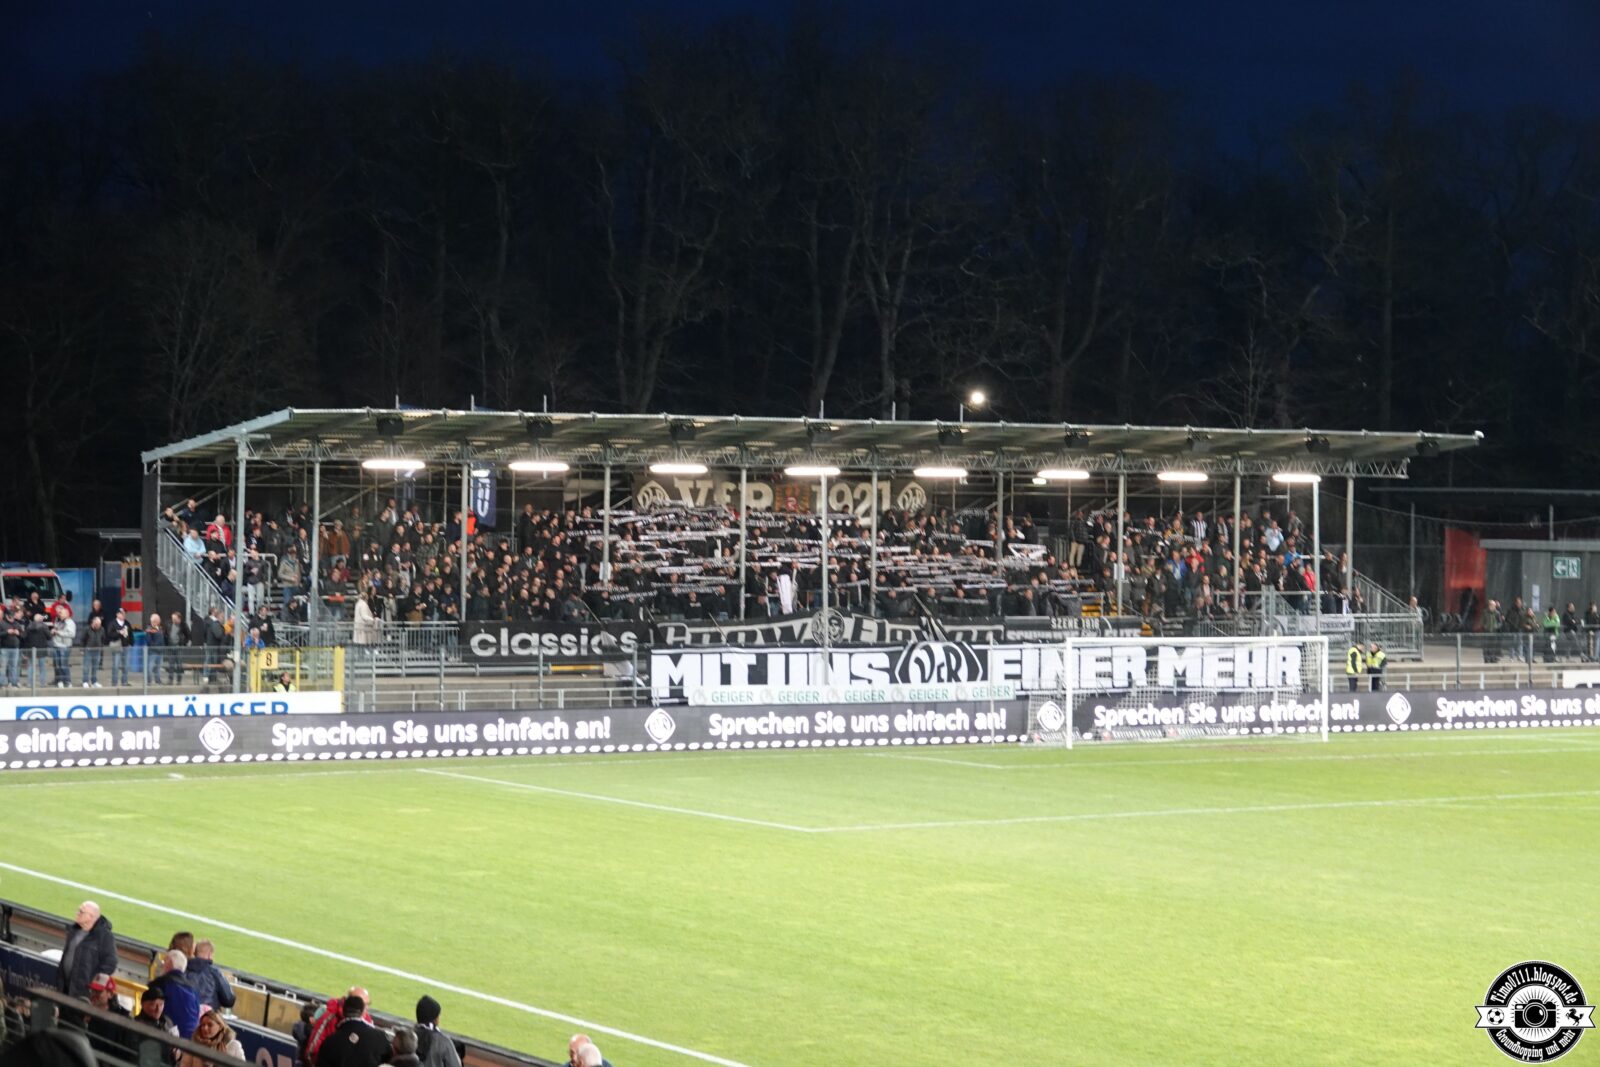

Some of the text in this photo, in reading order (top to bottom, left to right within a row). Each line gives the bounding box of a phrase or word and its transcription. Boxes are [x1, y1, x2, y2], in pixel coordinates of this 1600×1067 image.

[265, 652, 273, 667] 8
[651, 652, 756, 698] MIT
[768, 652, 890, 687] UNS
[992, 647, 1147, 690] EINER
[1158, 646, 1301, 688] MEHR
[711, 690, 754, 703] GEIGER
[778, 690, 820, 702] GEIGER
[844, 689, 887, 702] GEIGER
[908, 687, 950, 701] GEIGER
[971, 685, 1012, 699] GEIGER
[1093, 702, 1185, 731] Sprechen
[1188, 701, 1217, 724] Sie
[1221, 704, 1256, 723] uns
[1259, 699, 1324, 722] einfach
[1331, 699, 1360, 721] an!
[1436, 696, 1517, 722] Sprechen
[1520, 694, 1547, 716] Sie
[1550, 697, 1582, 715] uns
[271, 716, 611, 752] Sprechen Sie uns einfach an!
[708, 707, 1006, 741] Sprechen Sie uns einfach an!
[15, 726, 113, 753] einfach
[119, 726, 161, 751] an!
